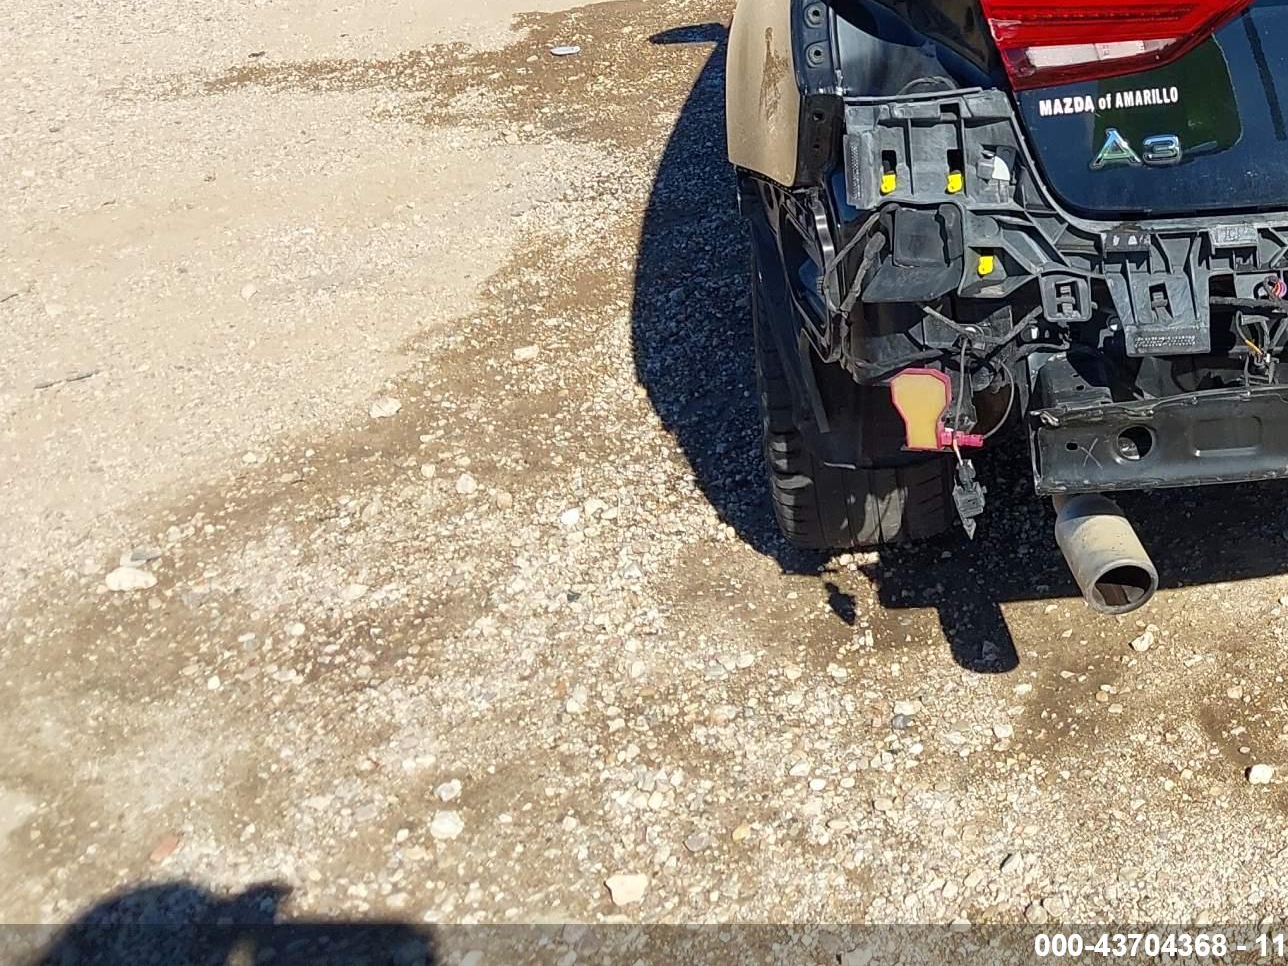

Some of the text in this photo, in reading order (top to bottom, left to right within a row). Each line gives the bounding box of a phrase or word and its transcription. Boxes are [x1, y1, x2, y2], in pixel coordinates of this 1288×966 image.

[1039, 86, 1180, 117] MAZDA of AMARILLO
[1089, 128, 1182, 170] A3
